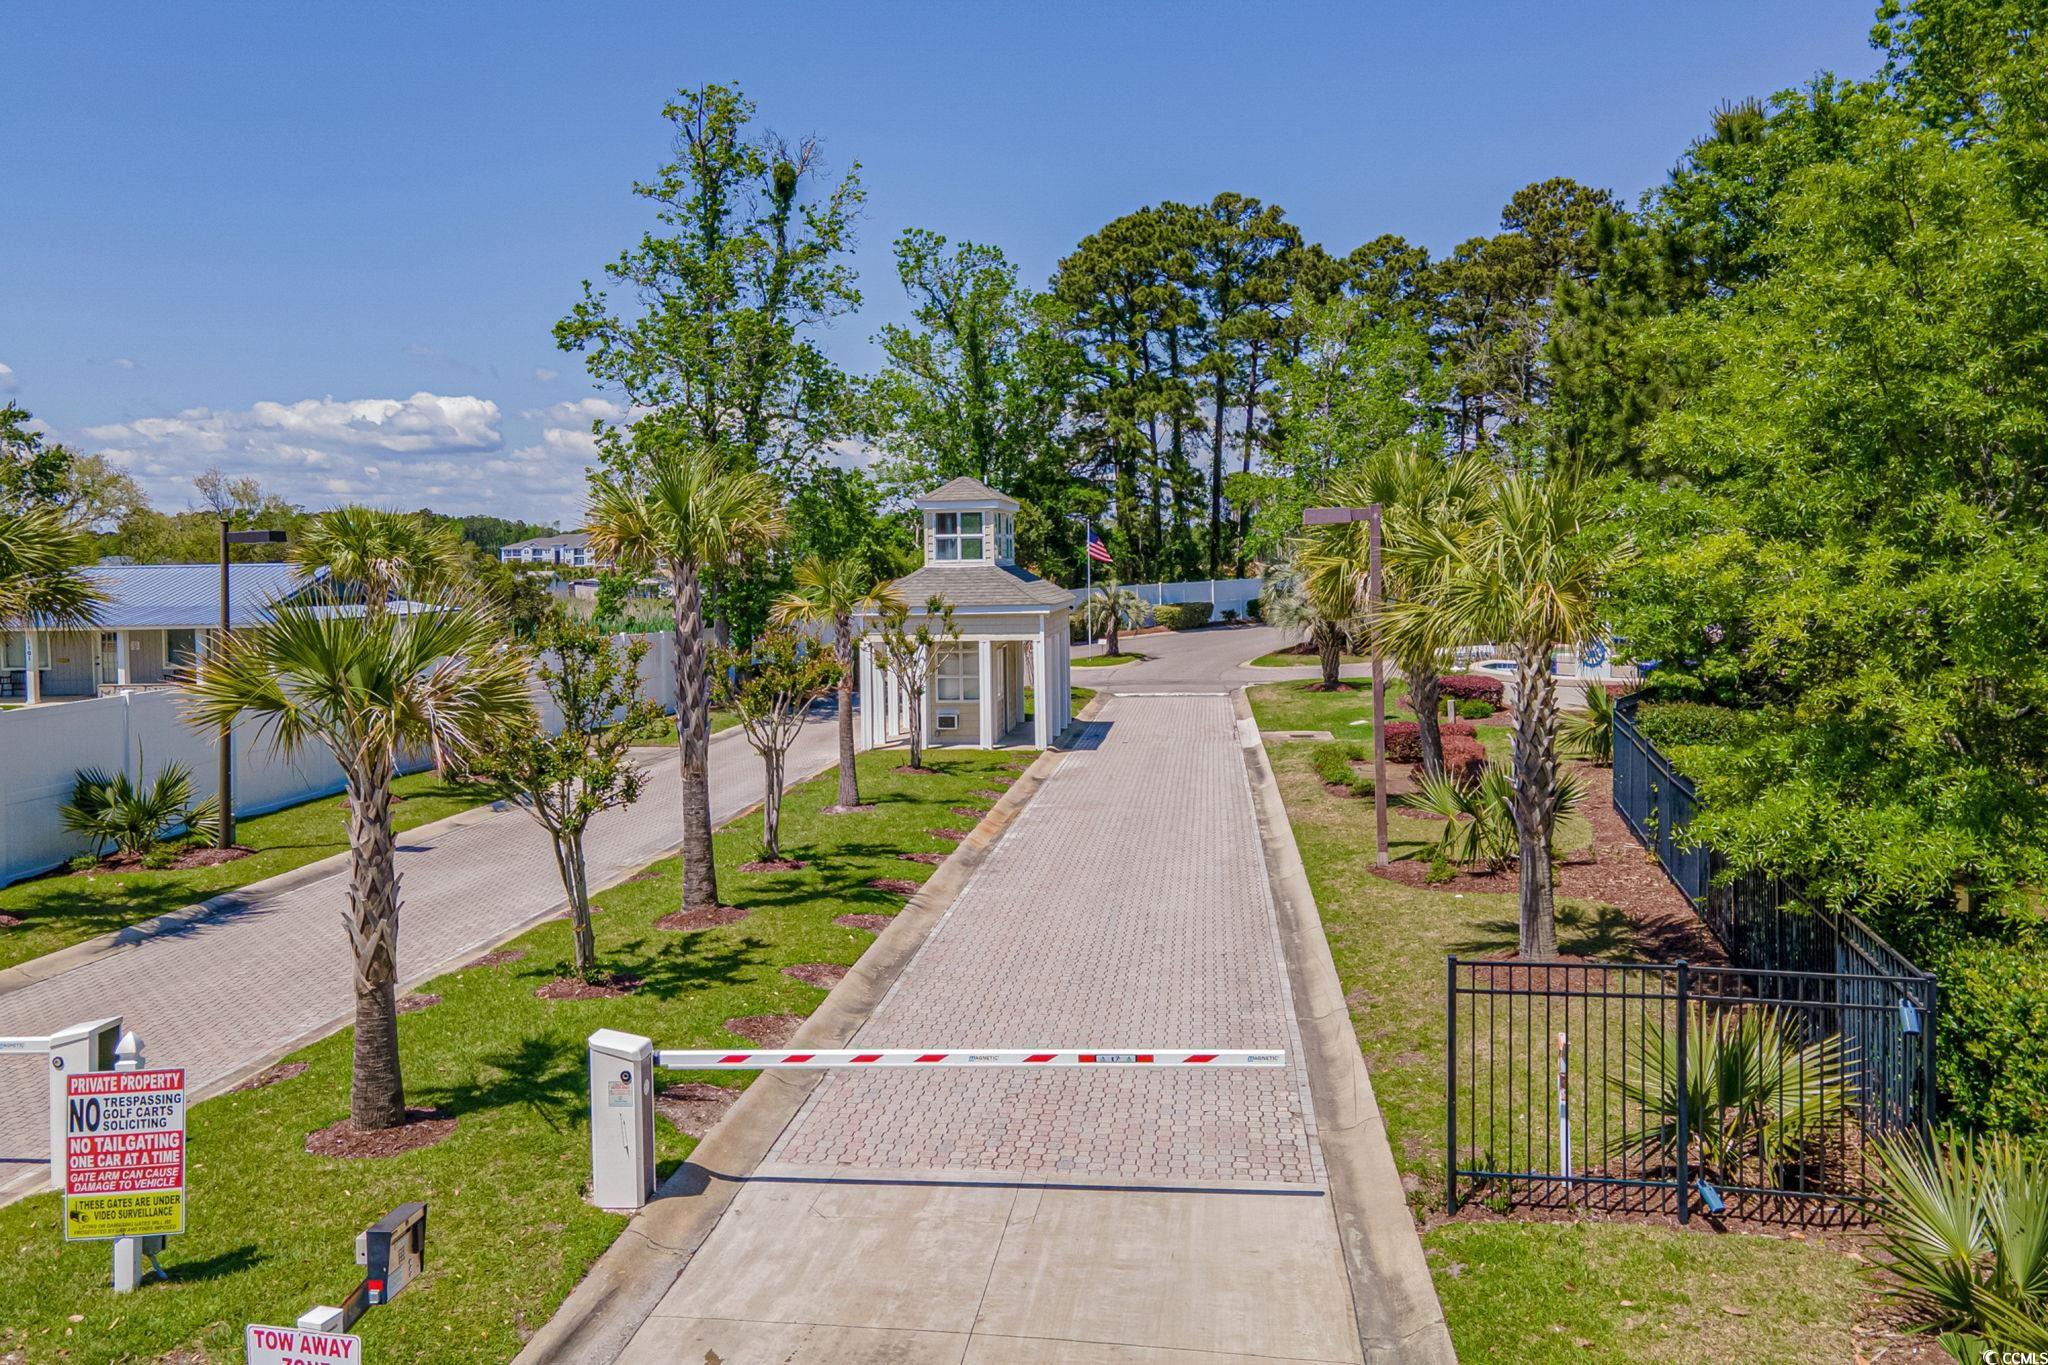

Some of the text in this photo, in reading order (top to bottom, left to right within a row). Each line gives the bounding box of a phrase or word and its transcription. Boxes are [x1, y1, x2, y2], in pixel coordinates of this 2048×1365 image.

[71, 1072, 180, 1094] PRIVATE PROPERTY
[103, 1093, 182, 1108] TRESPASSING
[70, 1097, 101, 1133] NO
[103, 1105, 174, 1120] GOLF CARTS
[103, 1117, 167, 1132] SOLICITING
[70, 1132, 180, 1154] NO TAILGATING
[70, 1150, 180, 1169] ONE CAR AT A TIME
[70, 1167, 179, 1183] GATE ARM CAN CAUSE
[73, 1177, 176, 1192] DAMAGE TO VEHICLE
[79, 1195, 181, 1210] THESE GATES ARE UNDER
[94, 1206, 173, 1221] VIDEO SURVEILLANCE
[253, 1329, 353, 1359] TOW AWAY
